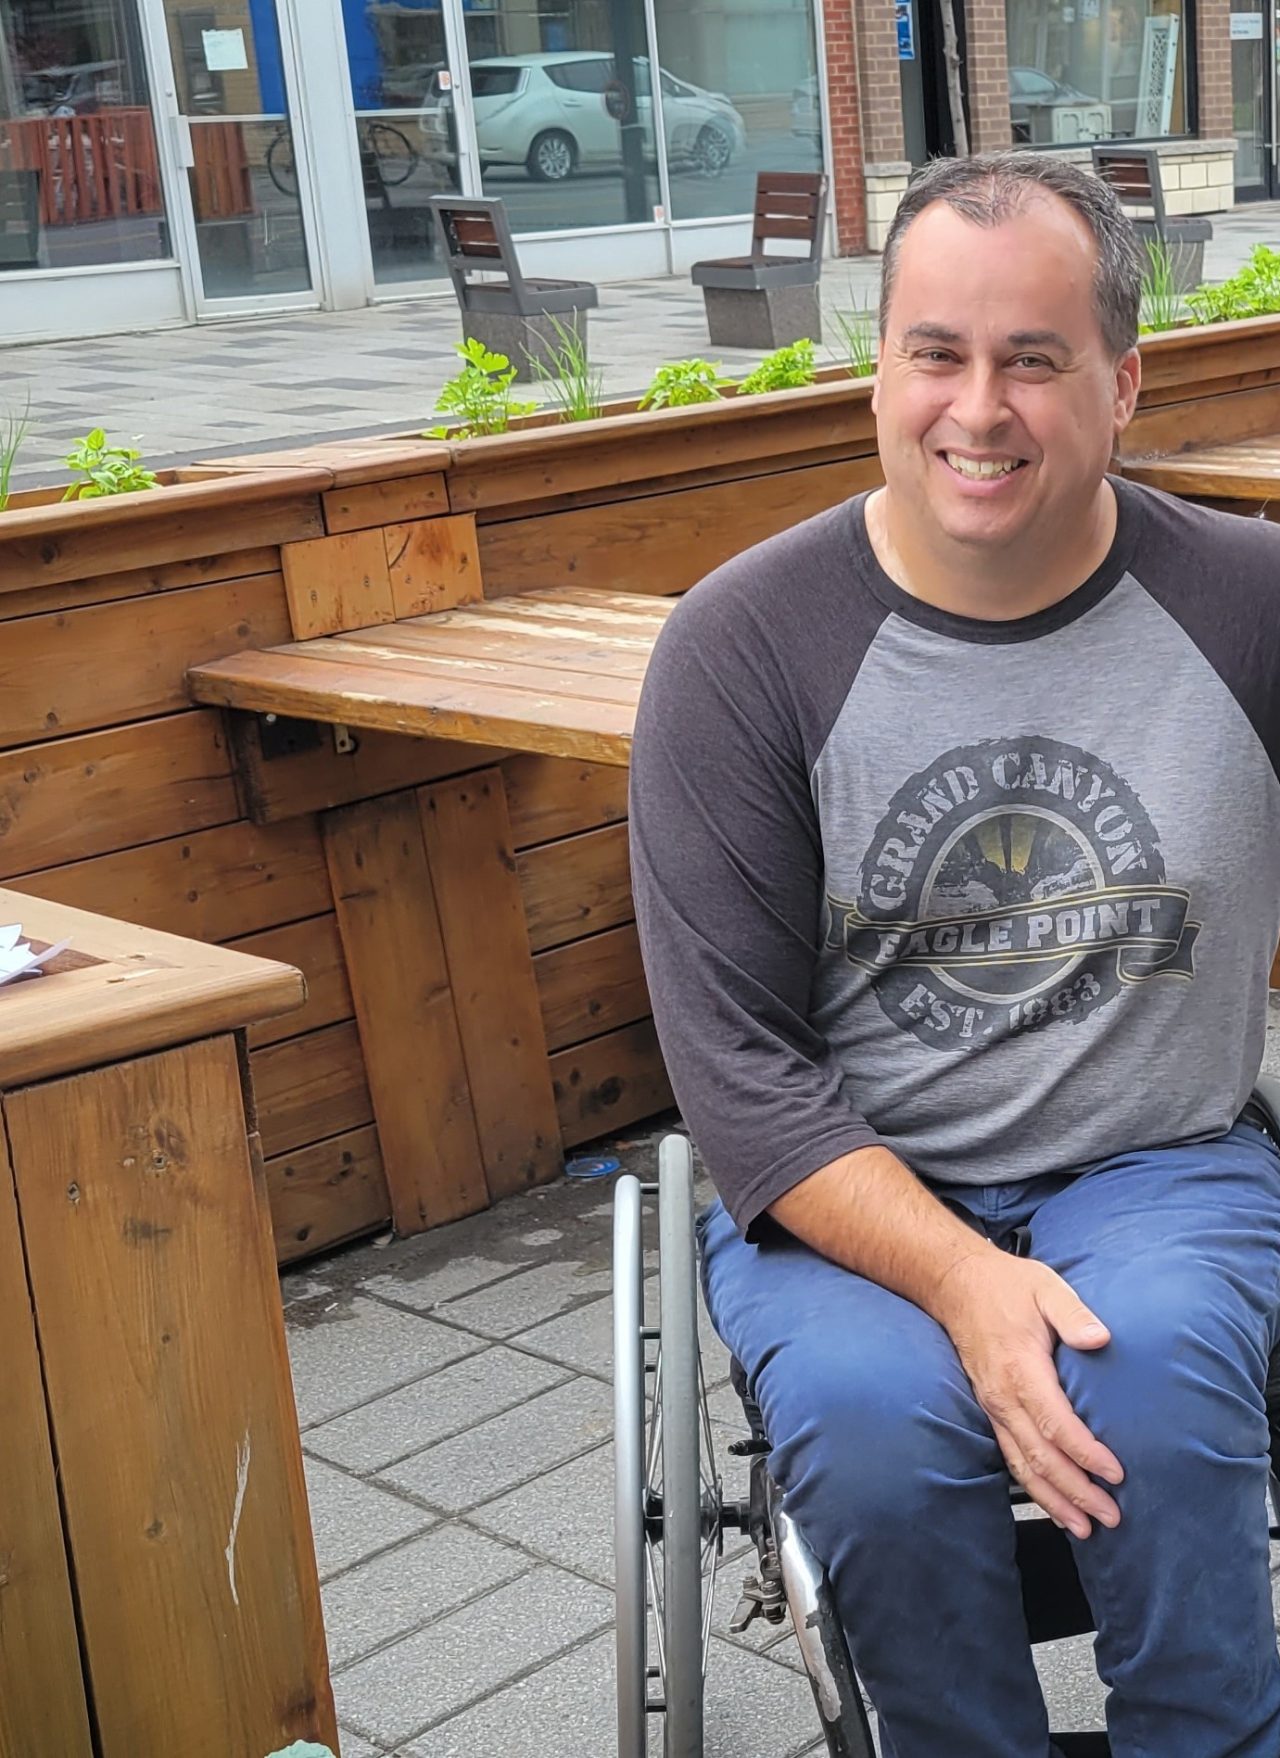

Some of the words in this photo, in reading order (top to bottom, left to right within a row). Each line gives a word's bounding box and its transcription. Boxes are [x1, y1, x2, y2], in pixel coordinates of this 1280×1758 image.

[870, 766, 980, 911] GRAND
[991, 752, 1149, 876] CANYON
[873, 918, 1013, 965] EAGLE
[1026, 898, 1161, 949] POINT
